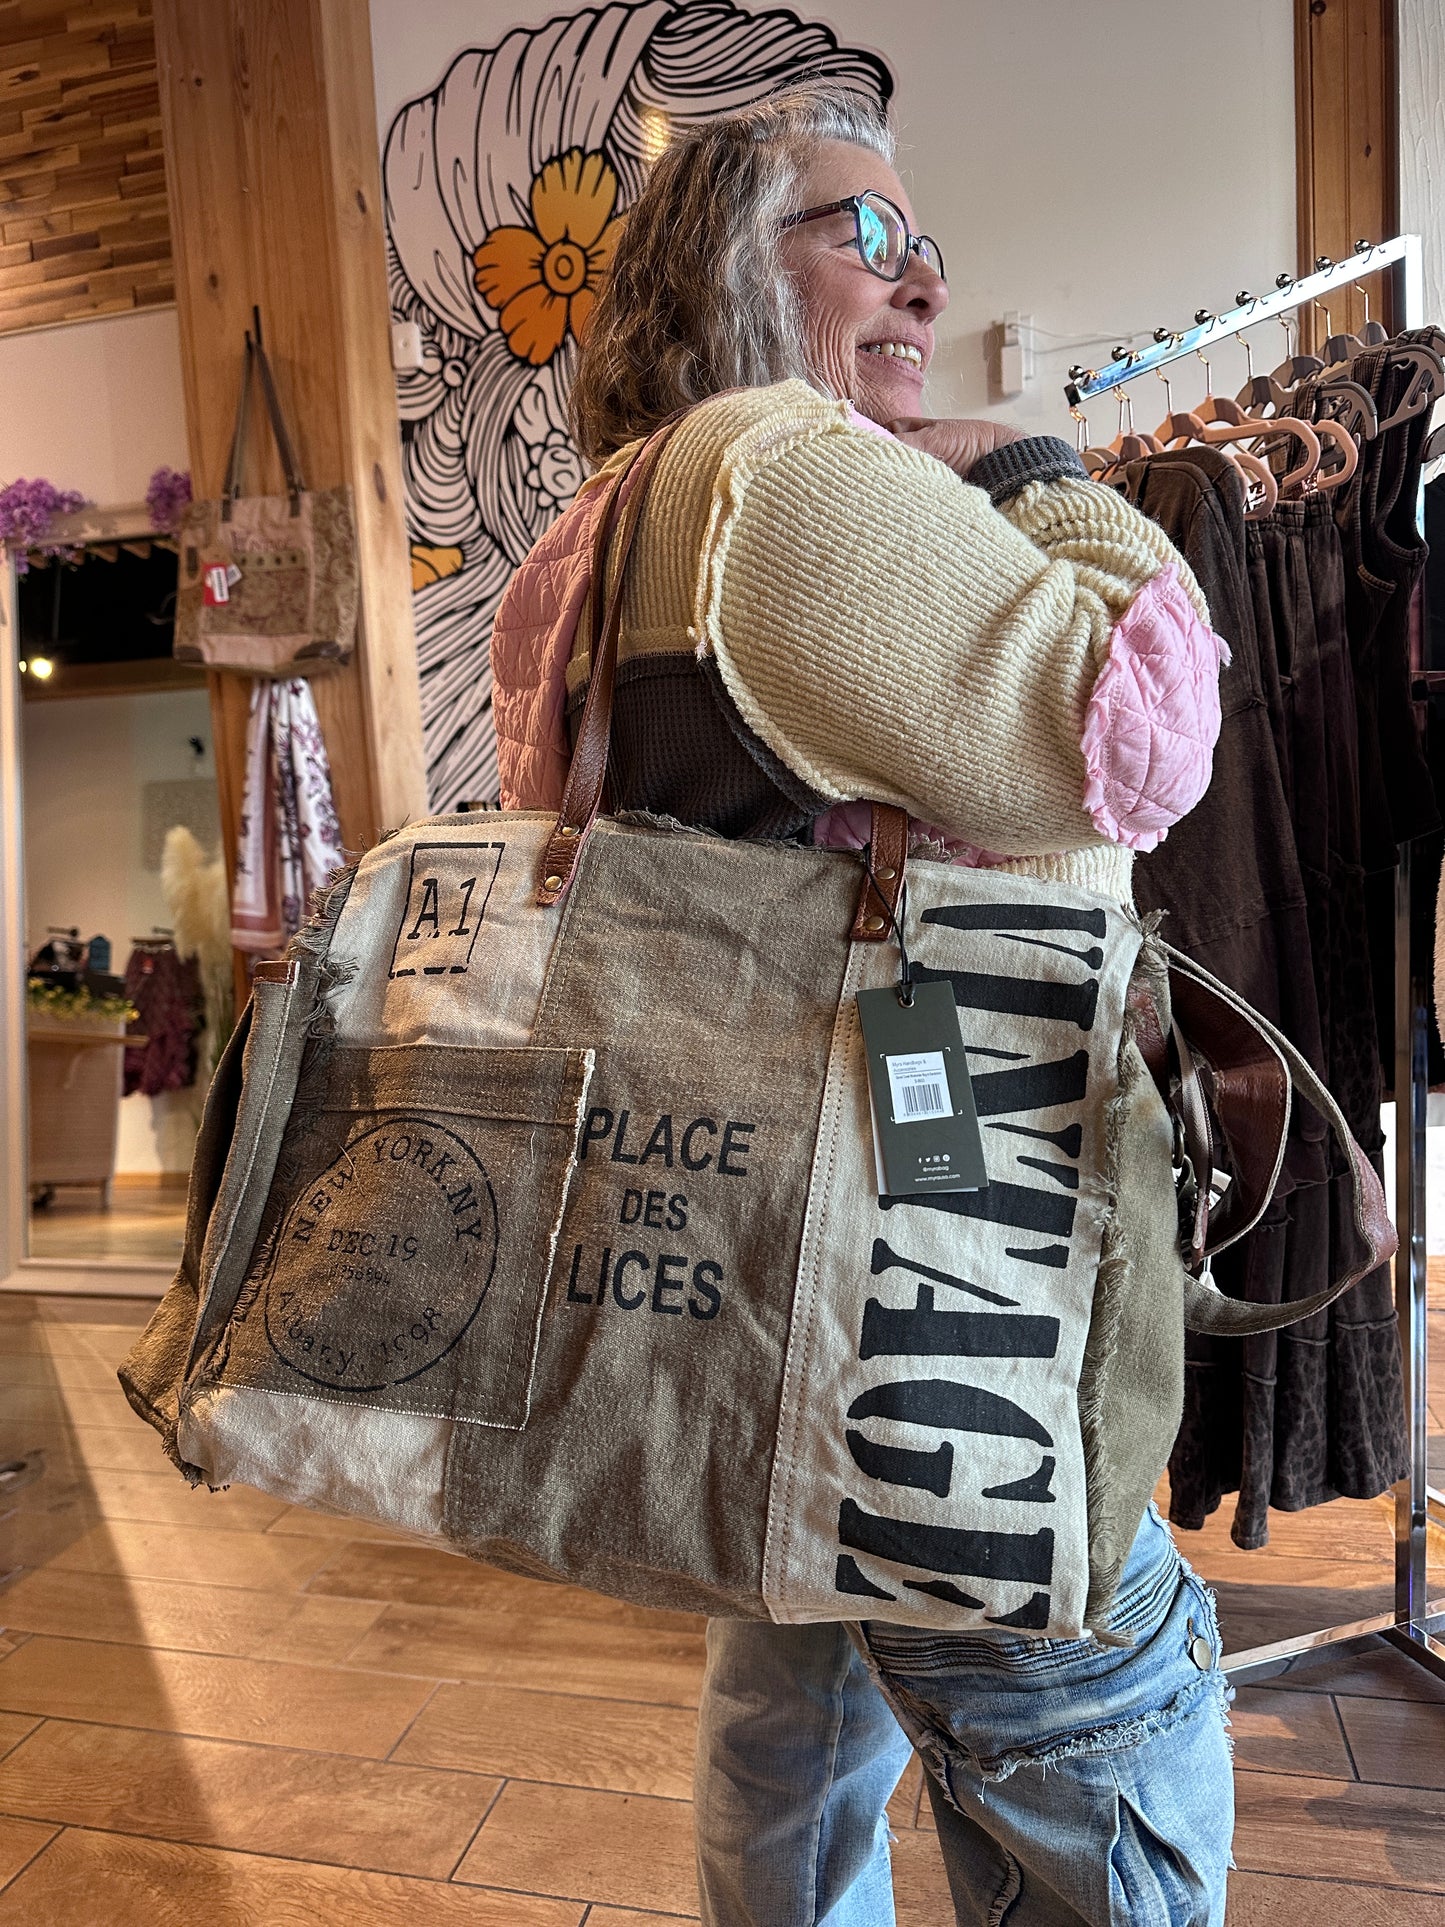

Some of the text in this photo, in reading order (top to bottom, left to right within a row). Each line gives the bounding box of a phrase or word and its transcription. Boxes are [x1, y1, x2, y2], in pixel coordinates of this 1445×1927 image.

[406, 876, 476, 940] A1
[579, 1106, 756, 1178] PLACE
[291, 1154, 358, 1245] NEW
[619, 1187, 689, 1232] DES
[326, 1228, 376, 1257] DEC
[835, 902, 1107, 1631] VINTAGE
[566, 1243, 724, 1321] LICES
